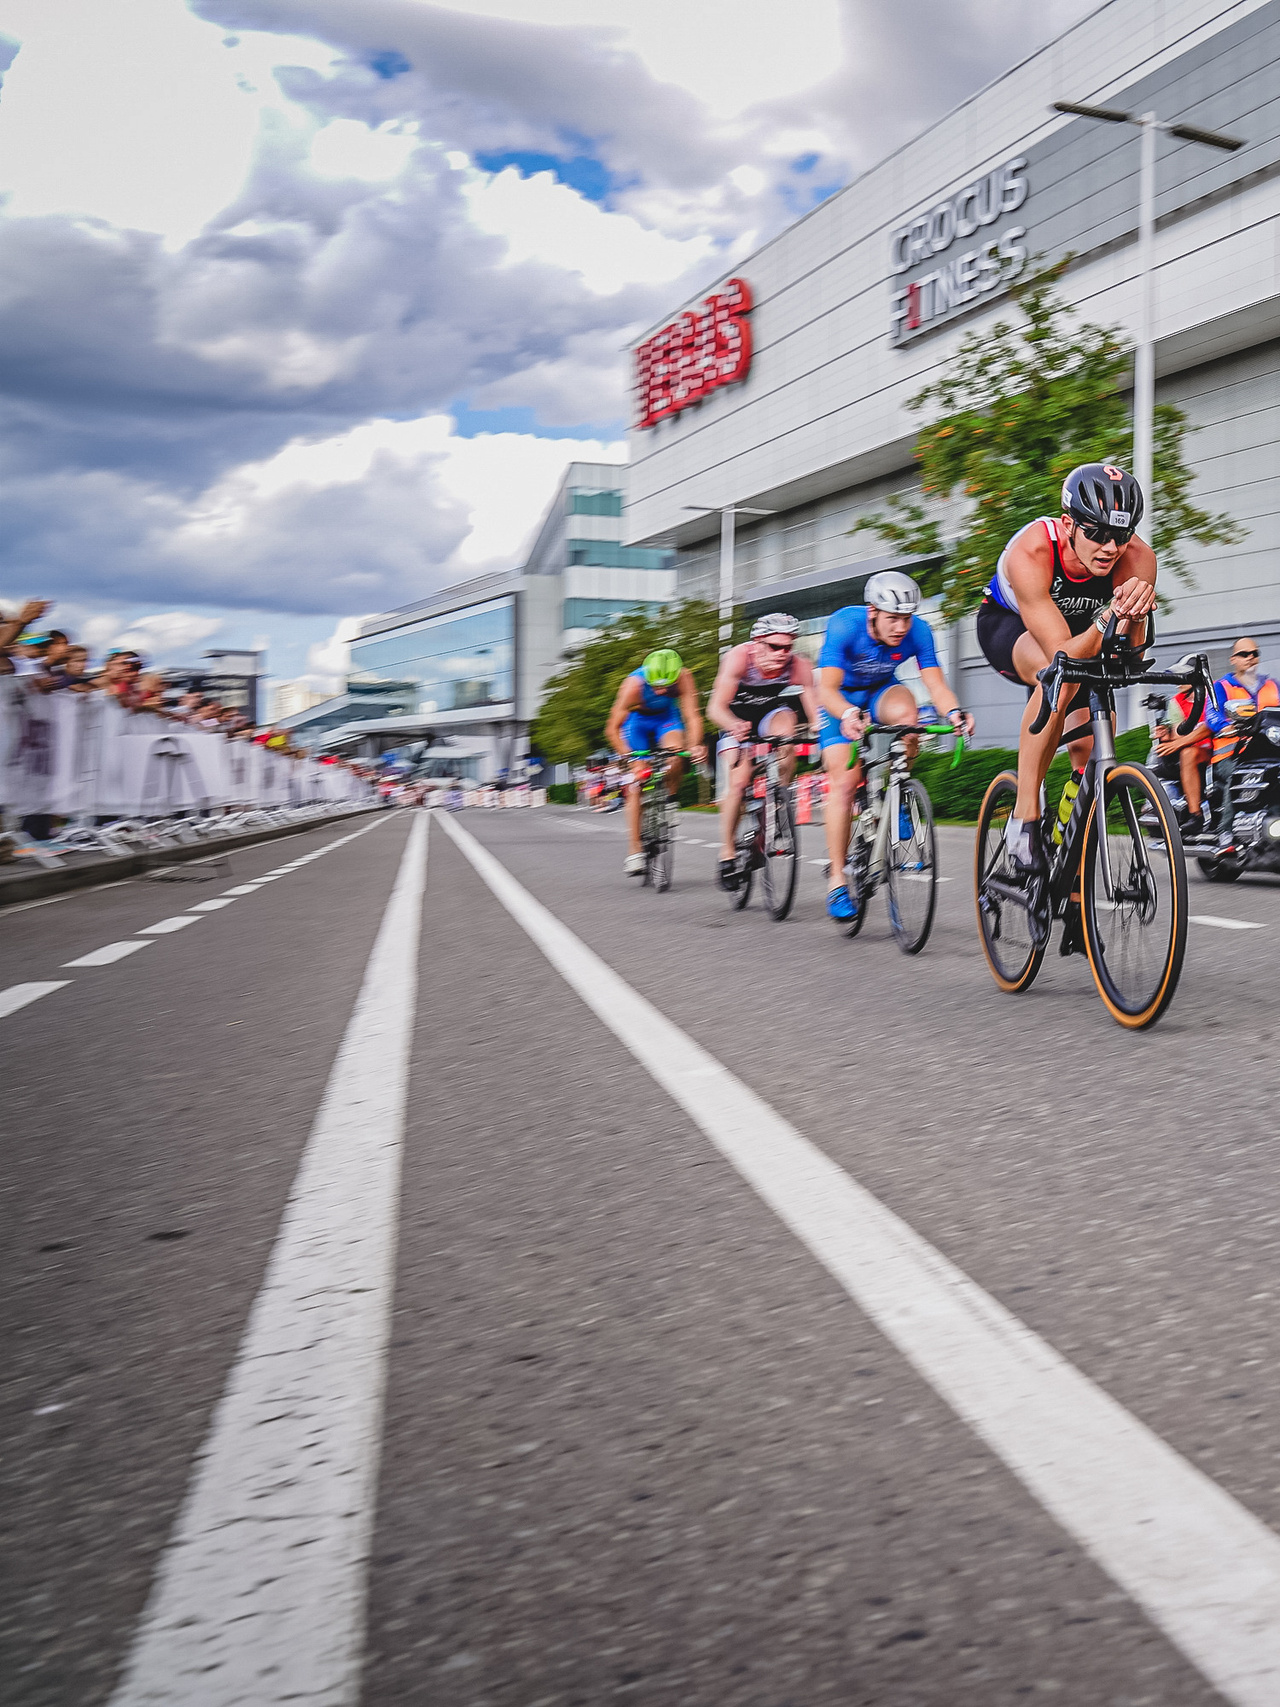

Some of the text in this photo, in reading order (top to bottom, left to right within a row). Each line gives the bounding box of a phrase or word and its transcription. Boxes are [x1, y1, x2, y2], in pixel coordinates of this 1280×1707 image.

[891, 157, 1029, 275] CROCUS
[890, 225, 1028, 340] FITNESS
[1114, 517, 1126, 525] 169
[1053, 597, 1104, 610] ERMITIN
